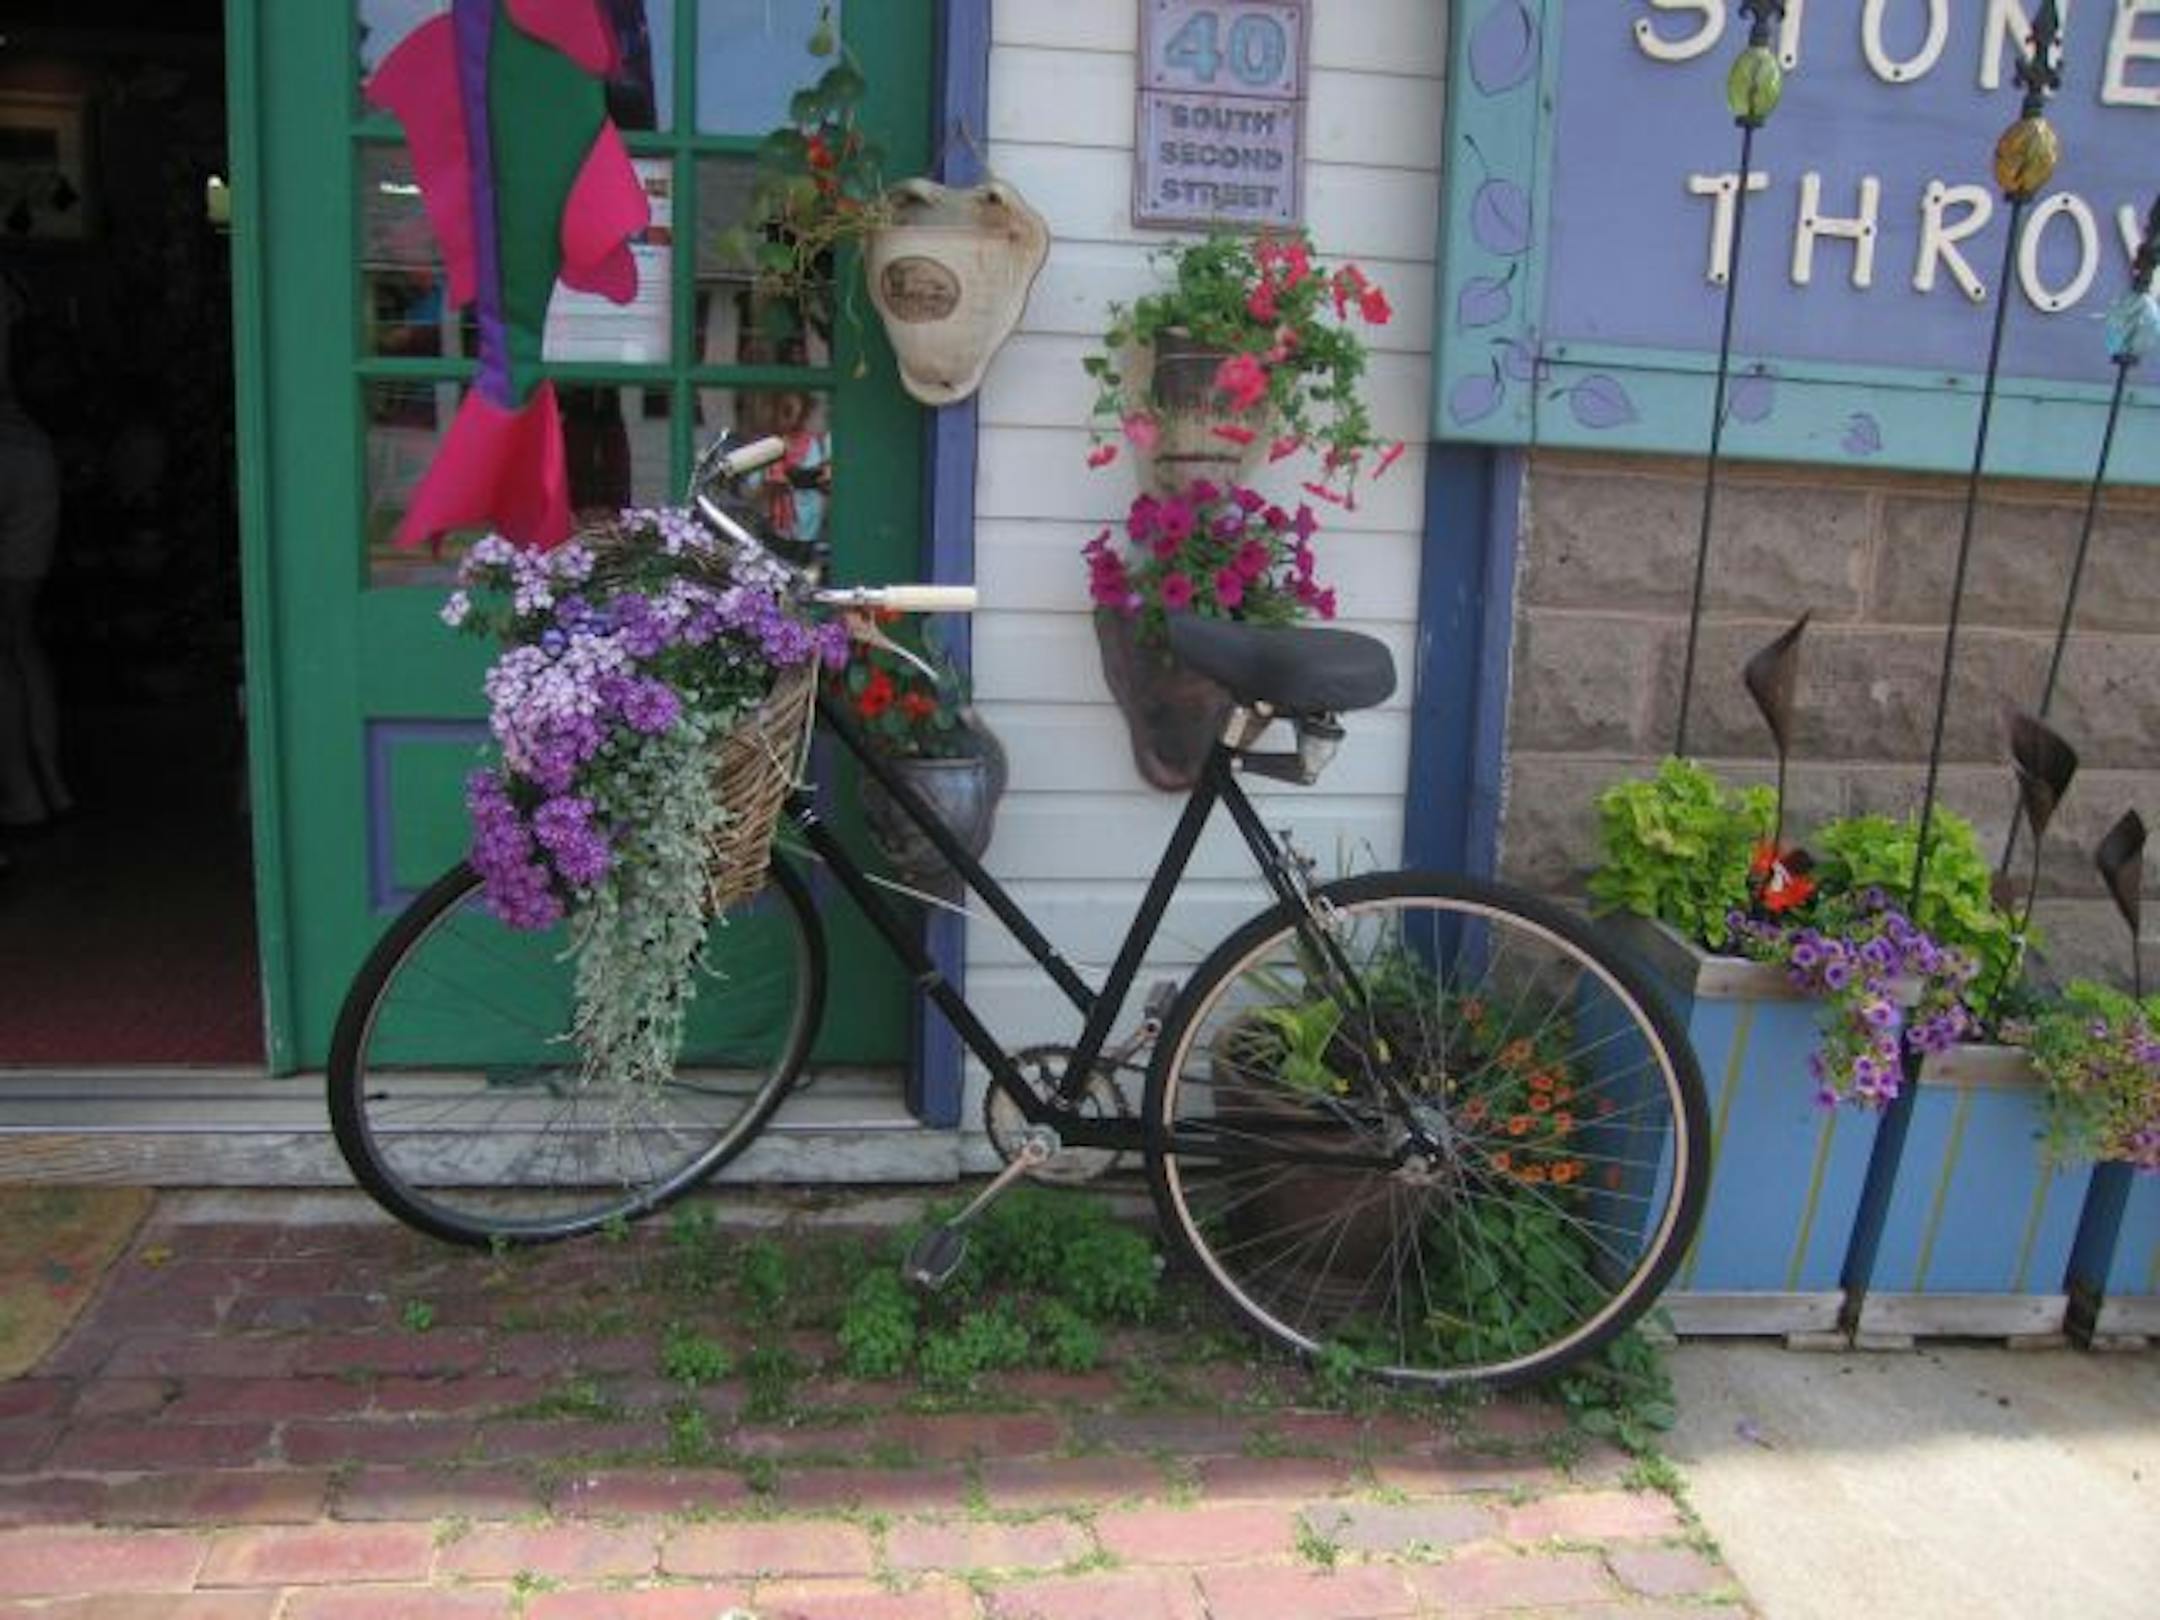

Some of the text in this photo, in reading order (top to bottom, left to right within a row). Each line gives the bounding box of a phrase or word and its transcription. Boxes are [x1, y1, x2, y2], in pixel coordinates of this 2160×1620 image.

[1164, 12, 1286, 86] 40
[1171, 105, 1275, 134] SOUTH
[1159, 142, 1283, 170] SECOND
[1160, 179, 1280, 209] STREET
[1688, 172, 2160, 313] THRO
